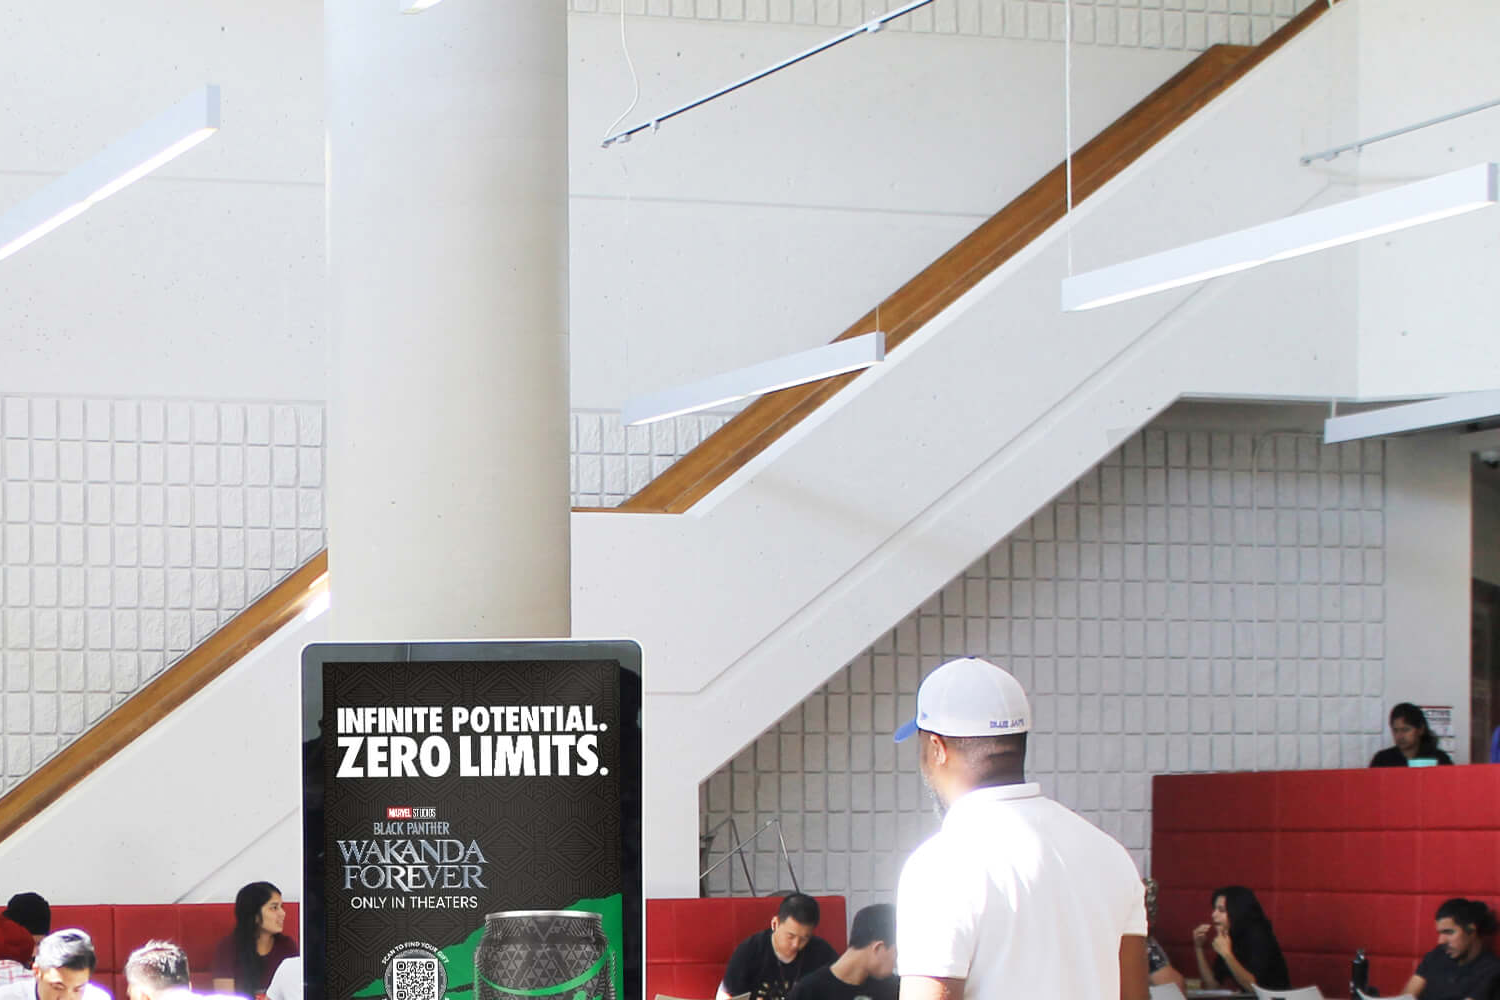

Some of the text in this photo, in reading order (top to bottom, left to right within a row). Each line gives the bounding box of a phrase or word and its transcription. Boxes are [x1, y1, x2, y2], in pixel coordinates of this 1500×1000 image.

[336, 705, 608, 734] INFINITE POTENTIAL.
[336, 734, 609, 778] ZERO LIMITS.
[388, 807, 436, 818] MARVEL STUDIOS
[373, 821, 450, 836] BLACK PANTHER
[336, 839, 489, 864] WAKANDA
[342, 865, 488, 893] FOREVER
[351, 896, 478, 909] ONLY IN THEATERS
[381, 949, 396, 964] SCAN
[395, 944, 404, 952] TO
[421, 942, 438, 952] YOUR
